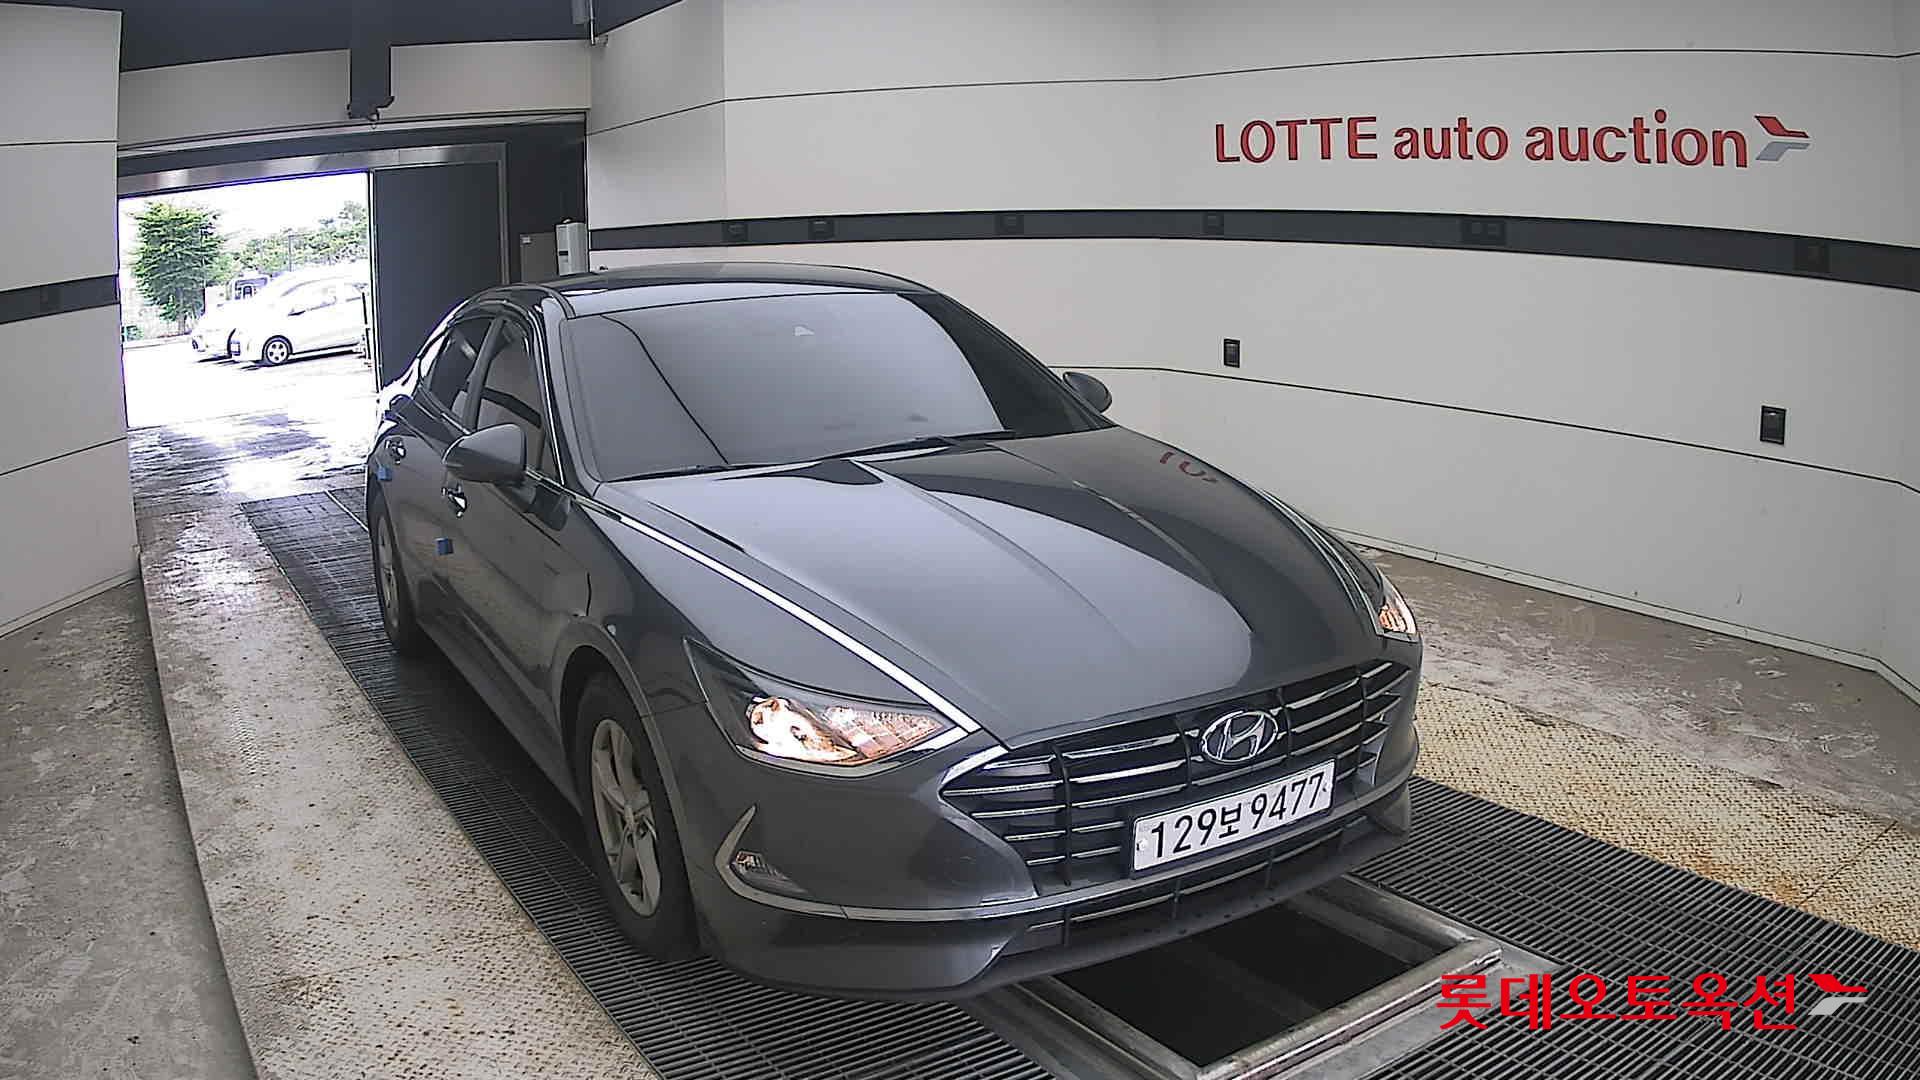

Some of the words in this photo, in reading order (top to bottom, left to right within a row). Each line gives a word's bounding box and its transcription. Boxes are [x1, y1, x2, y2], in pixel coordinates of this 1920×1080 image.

[1215, 116, 1378, 163] LOTTE
[1393, 116, 1509, 161] auto
[1524, 109, 1748, 168] auction
